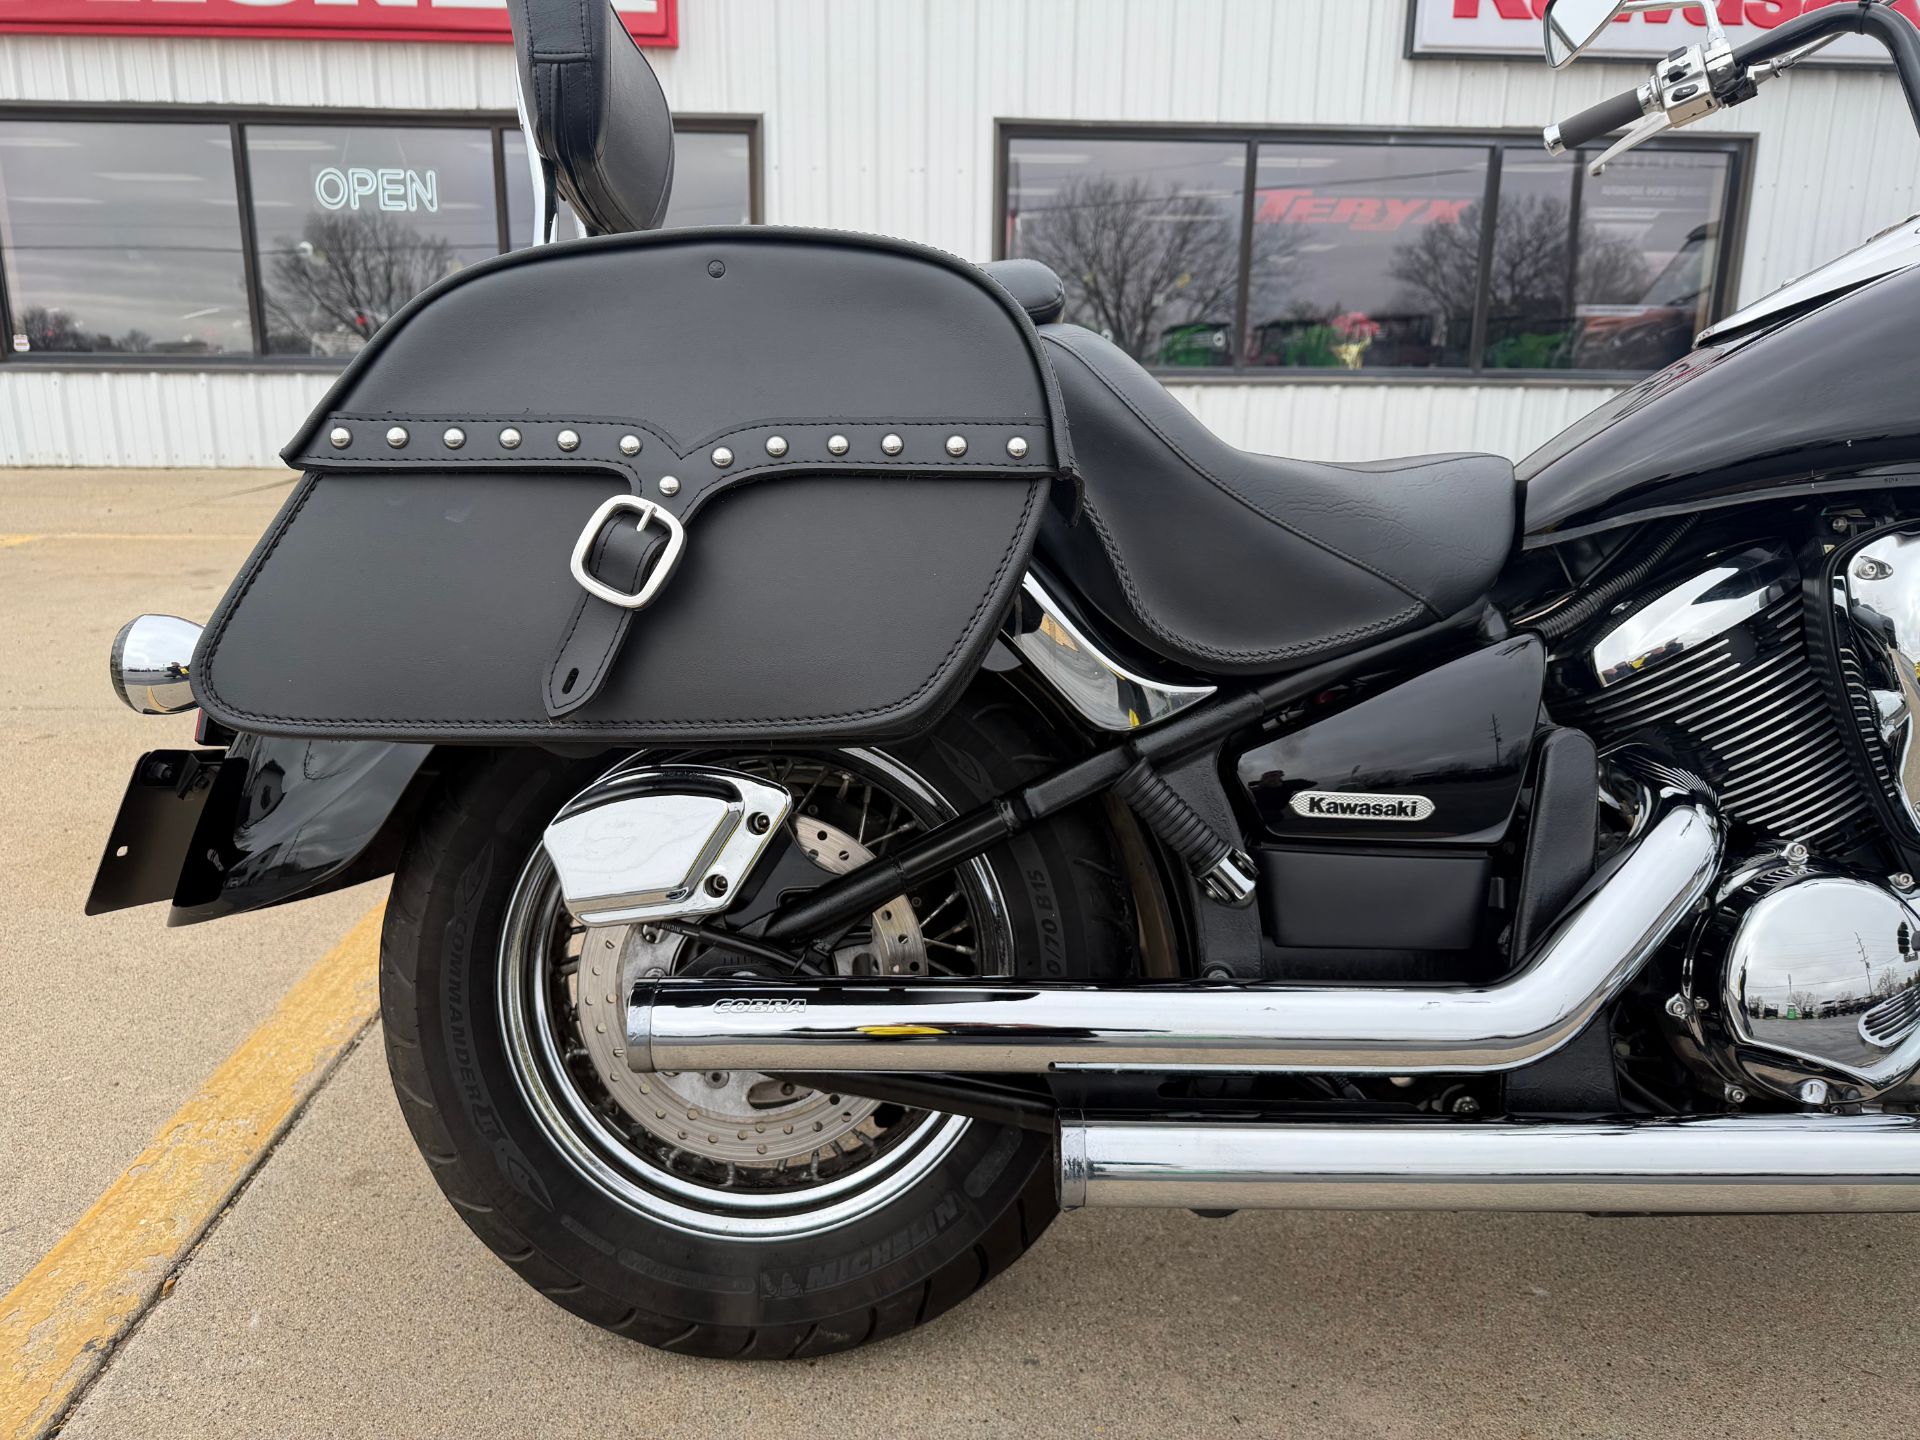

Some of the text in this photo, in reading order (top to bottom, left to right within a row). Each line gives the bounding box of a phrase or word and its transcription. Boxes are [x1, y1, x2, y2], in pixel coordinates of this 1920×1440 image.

[316, 168, 438, 212] OPEN
[1308, 796, 1418, 817] Kawasaki
[1041, 918, 1062, 976] 0/70
[448, 916, 481, 1101] COMMANDER
[713, 998, 807, 1014] COBRA
[808, 1194, 959, 1288] MICHELIN
